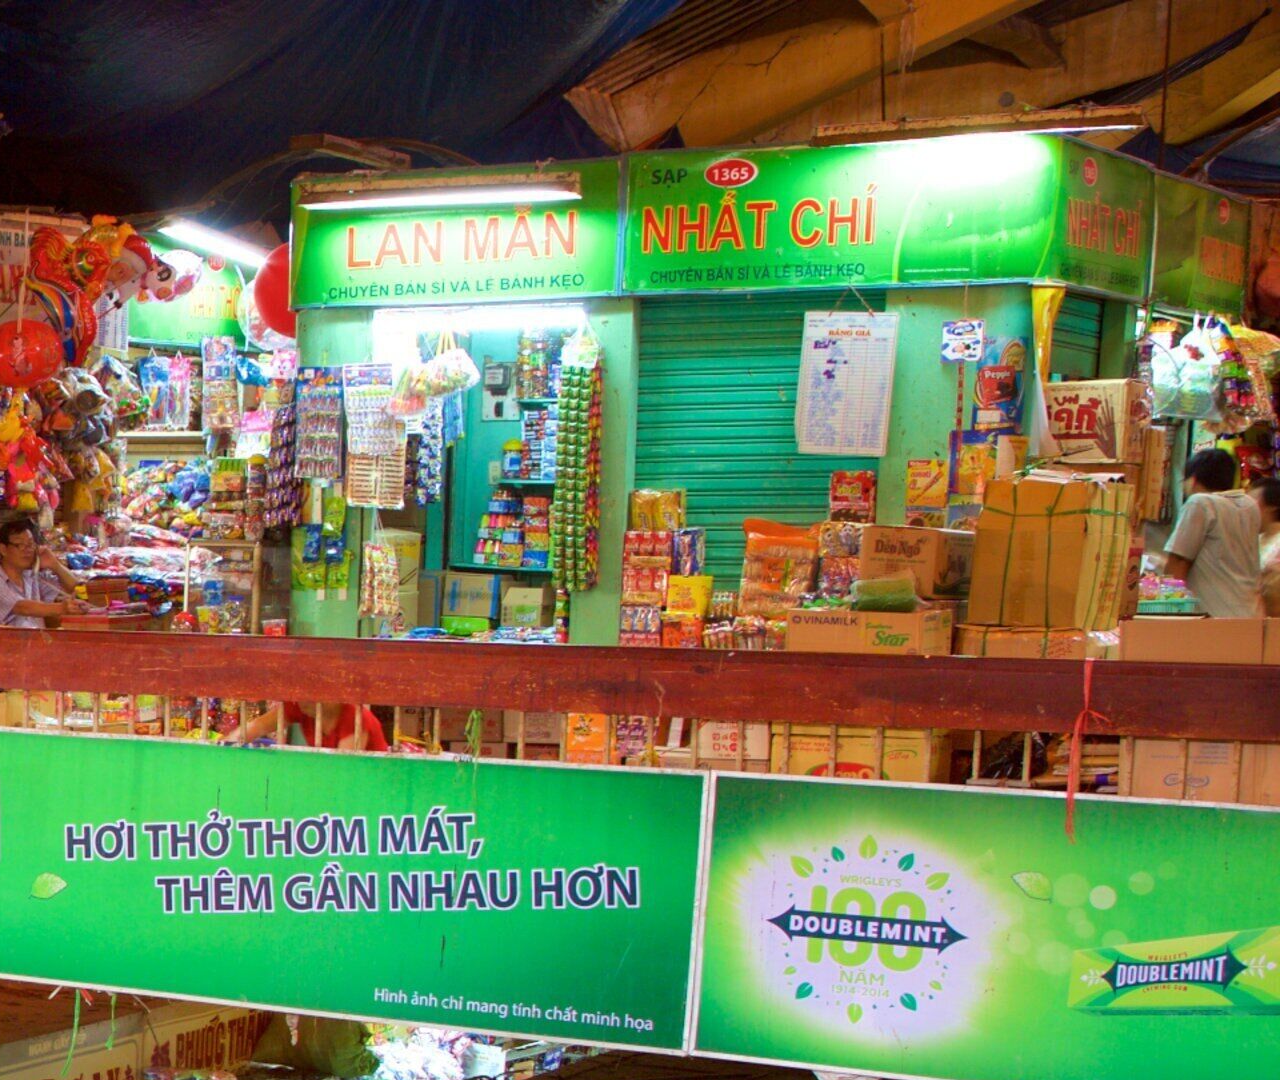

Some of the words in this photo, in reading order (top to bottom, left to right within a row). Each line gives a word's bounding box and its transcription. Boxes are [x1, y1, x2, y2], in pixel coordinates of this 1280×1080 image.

[650, 168, 688, 189] SẠP
[712, 167, 750, 182] 1365
[641, 189, 778, 255] NHẤT
[789, 181, 878, 248] CHÍ
[346, 220, 441, 269] LAN
[803, 614, 859, 627] VINAMILK
[872, 629, 910, 648] Star
[64, 821, 137, 863] HƠI
[142, 809, 233, 861] THỞ
[238, 814, 369, 858] THƠM
[377, 805, 485, 861] MÁT,
[155, 866, 276, 915] THÊM
[283, 861, 380, 914] GẦN
[388, 867, 520, 913] NHAU
[531, 863, 641, 911] HƠN
[839, 873, 903, 888] WRIGLEY'S
[789, 914, 947, 944] DOUBLEMINT
[805, 884, 927, 973] 100
[839, 968, 886, 987] NĂM
[1115, 955, 1228, 988] DOUBLEMINT
[831, 983, 890, 998] 1914-2014
[373, 987, 408, 1006] Hình
[411, 989, 439, 1008] ảnh
[441, 995, 465, 1012] chỉ
[466, 999, 510, 1020] mang
[512, 1003, 542, 1020] tính
[544, 1005, 578, 1023] chất
[581, 1010, 621, 1029] minh
[624, 1014, 655, 1034] họa
